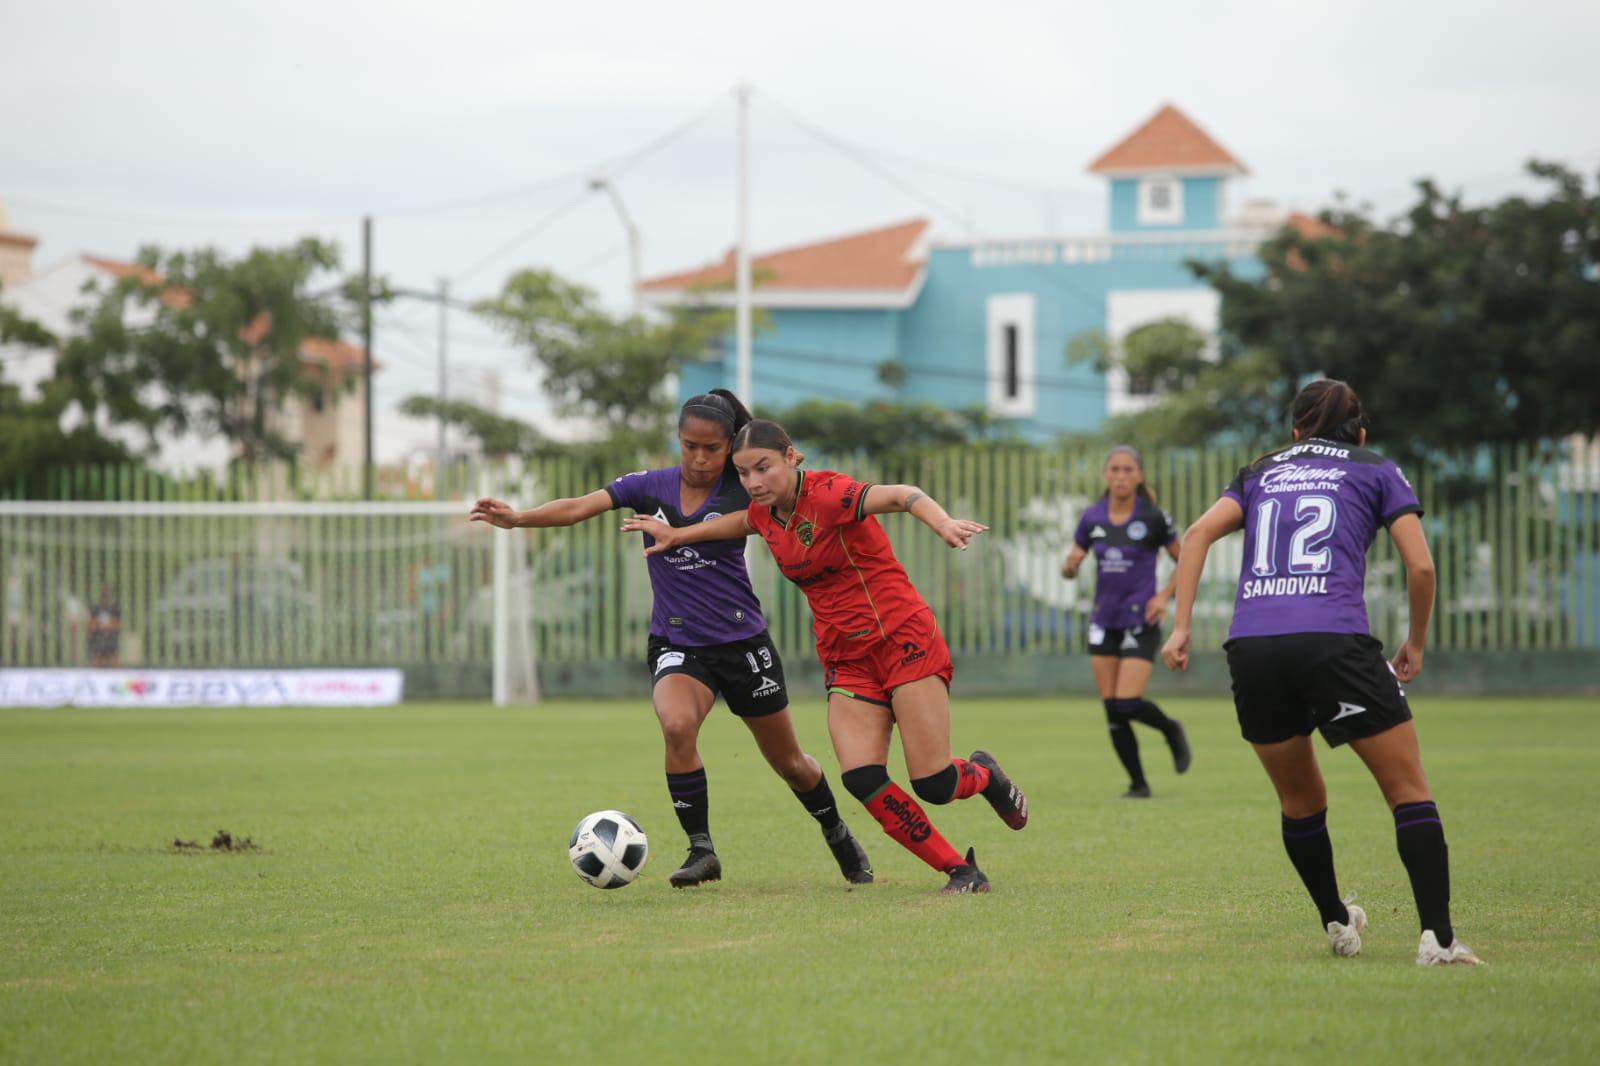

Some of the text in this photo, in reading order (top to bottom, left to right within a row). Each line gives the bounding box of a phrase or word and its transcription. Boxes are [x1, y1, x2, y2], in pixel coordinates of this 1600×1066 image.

[1272, 442, 1350, 462] Corona
[1259, 463, 1348, 487] Caliente
[1252, 495, 1336, 577] 12
[1243, 576, 1328, 599] SANDOVAL
[745, 646, 773, 673] 13
[752, 685, 780, 698] PIRMA
